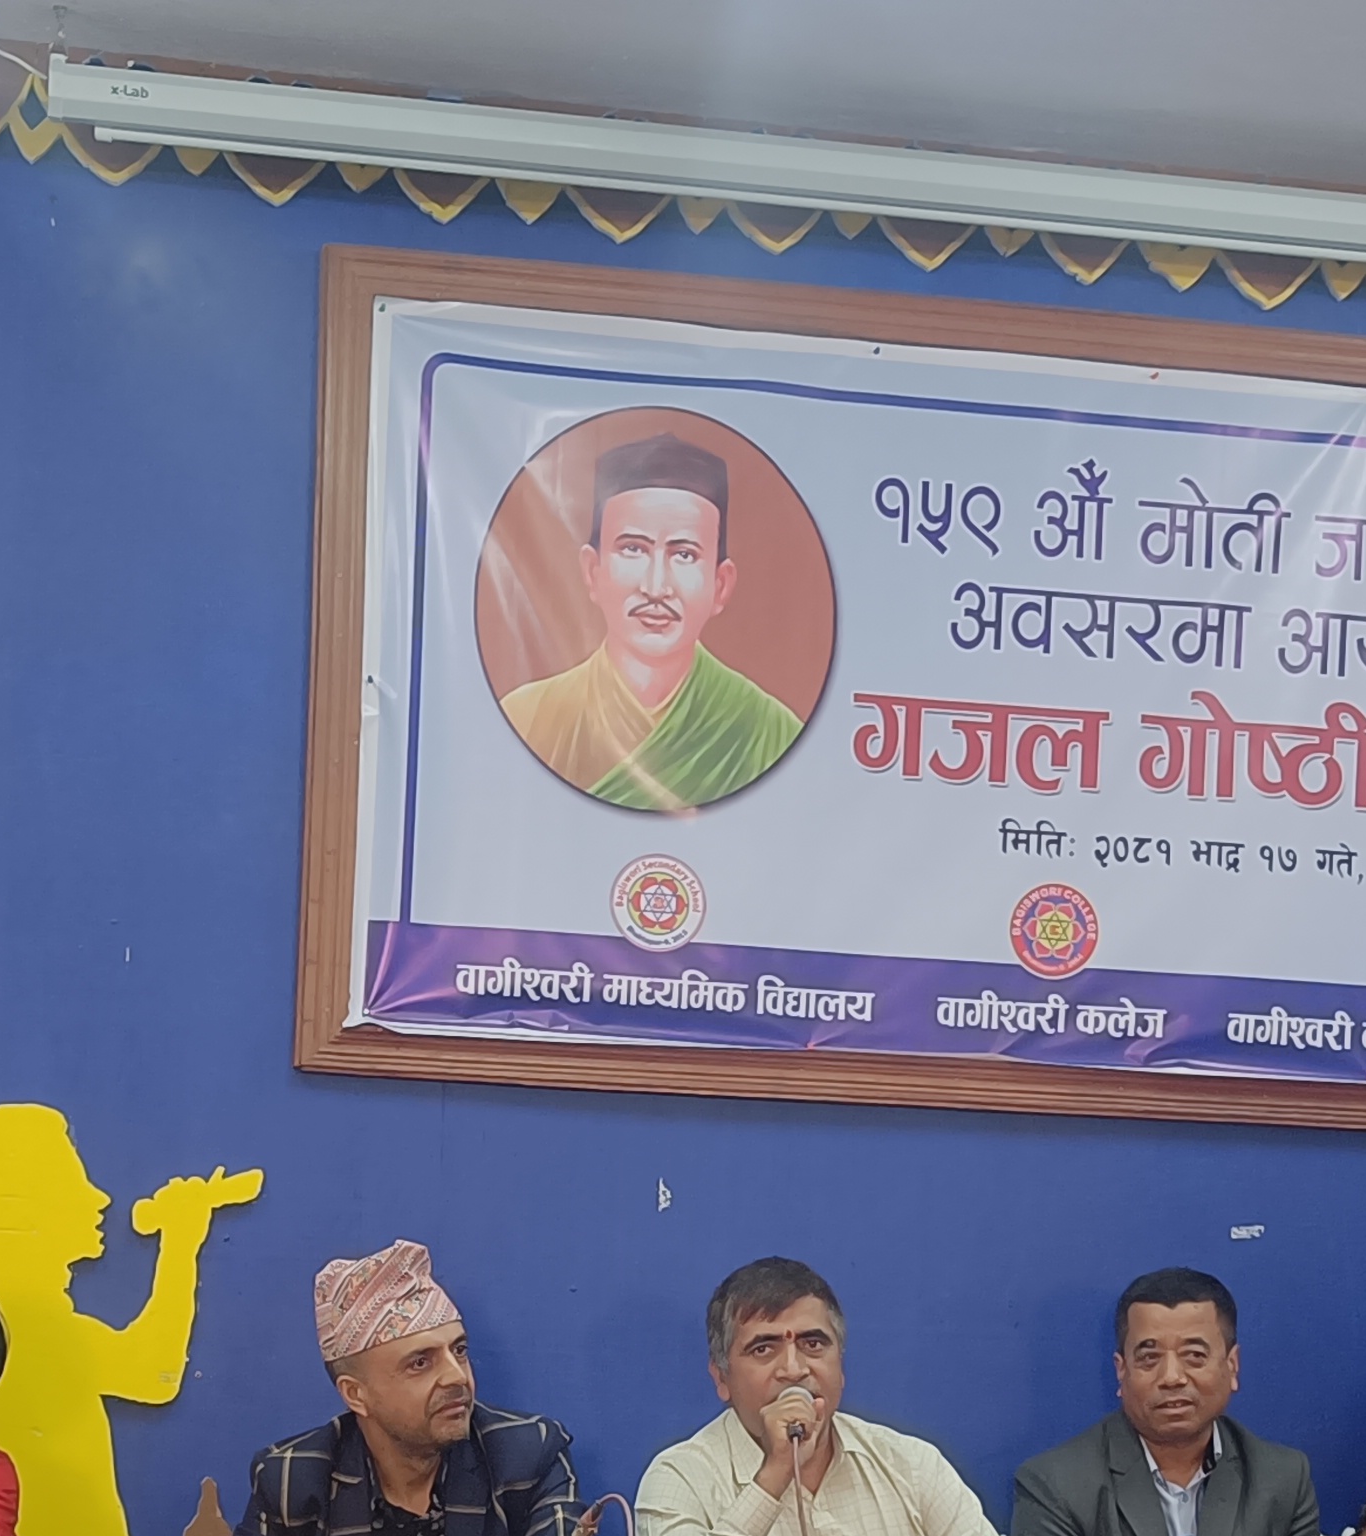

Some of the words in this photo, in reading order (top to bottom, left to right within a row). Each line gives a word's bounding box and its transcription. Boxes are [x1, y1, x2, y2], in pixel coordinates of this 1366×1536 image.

[875, 477, 1001, 557] १५९
[1138, 477, 1291, 574] मोती
[950, 582, 1252, 669] अवसरमा
[853, 693, 1111, 792] गजल
[1094, 836, 1171, 867] २०८१
[1190, 840, 1245, 872] भाद्र
[1260, 845, 1297, 872] १७
[1315, 843, 1364, 884] गते,
[456, 958, 594, 1003] वागीश्वरी
[603, 969, 748, 1013] माध्यमिक
[756, 974, 875, 1022] विद्यालय
[937, 990, 1069, 1034] वागीश्वरी
[1076, 998, 1167, 1038] कलेज
[1227, 1007, 1355, 1050] वागीश्वरी
